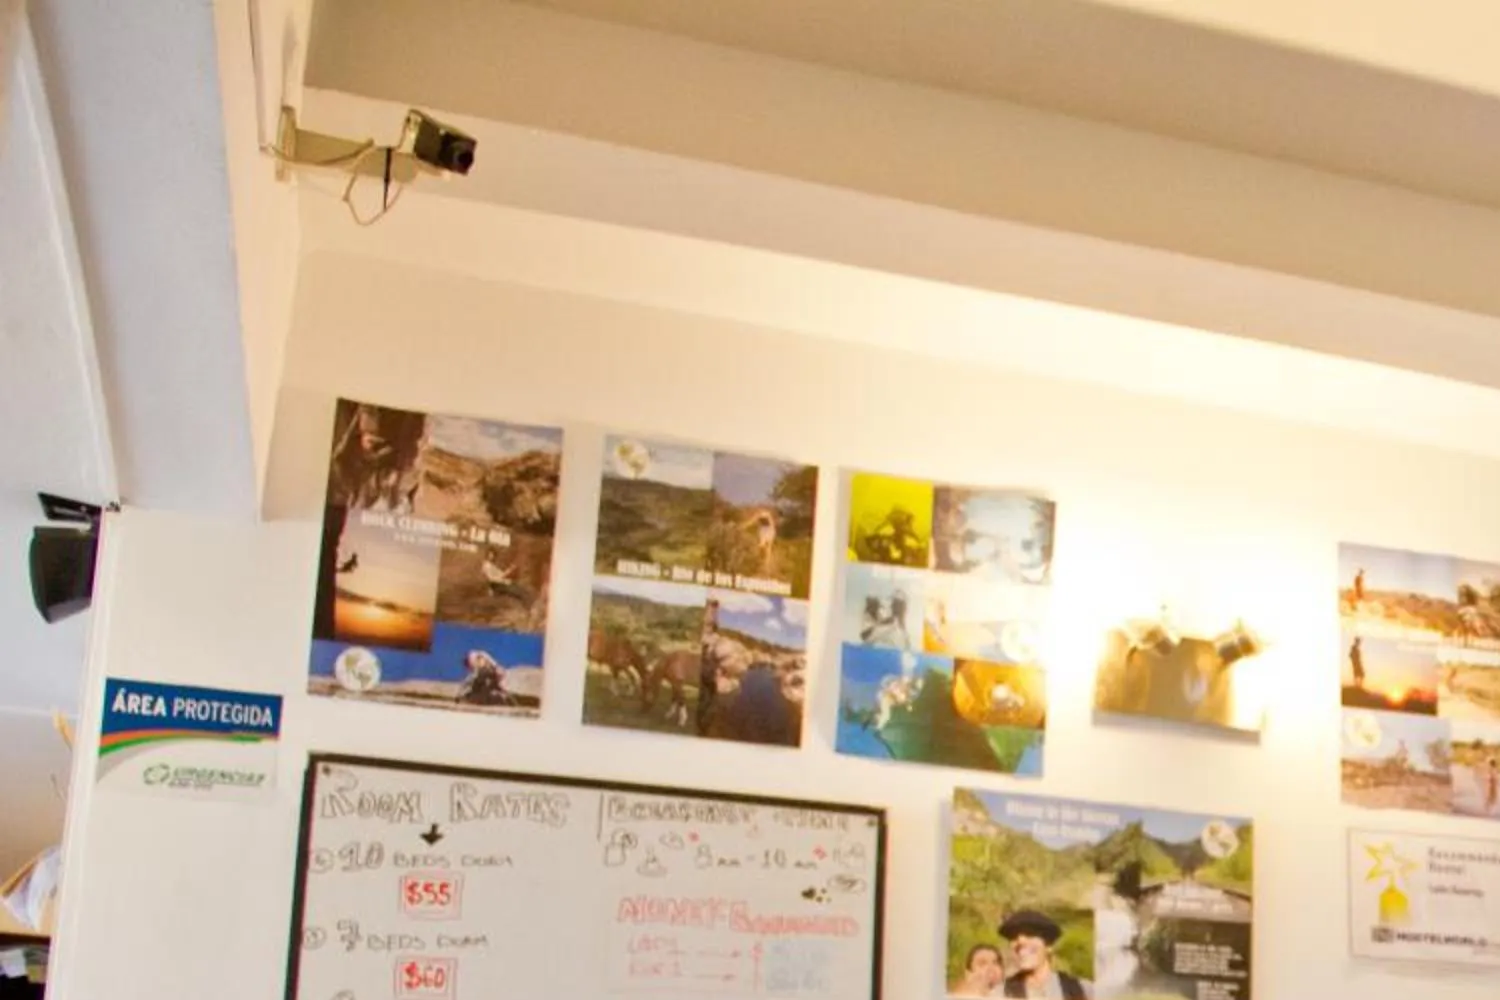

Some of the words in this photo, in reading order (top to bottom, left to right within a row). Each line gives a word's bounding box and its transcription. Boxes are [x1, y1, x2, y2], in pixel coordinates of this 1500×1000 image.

[112, 687, 167, 717] ÁREA
[172, 697, 273, 727] PROTEGIDA
[405, 882, 452, 905] $55
[404, 962, 446, 990] $60
